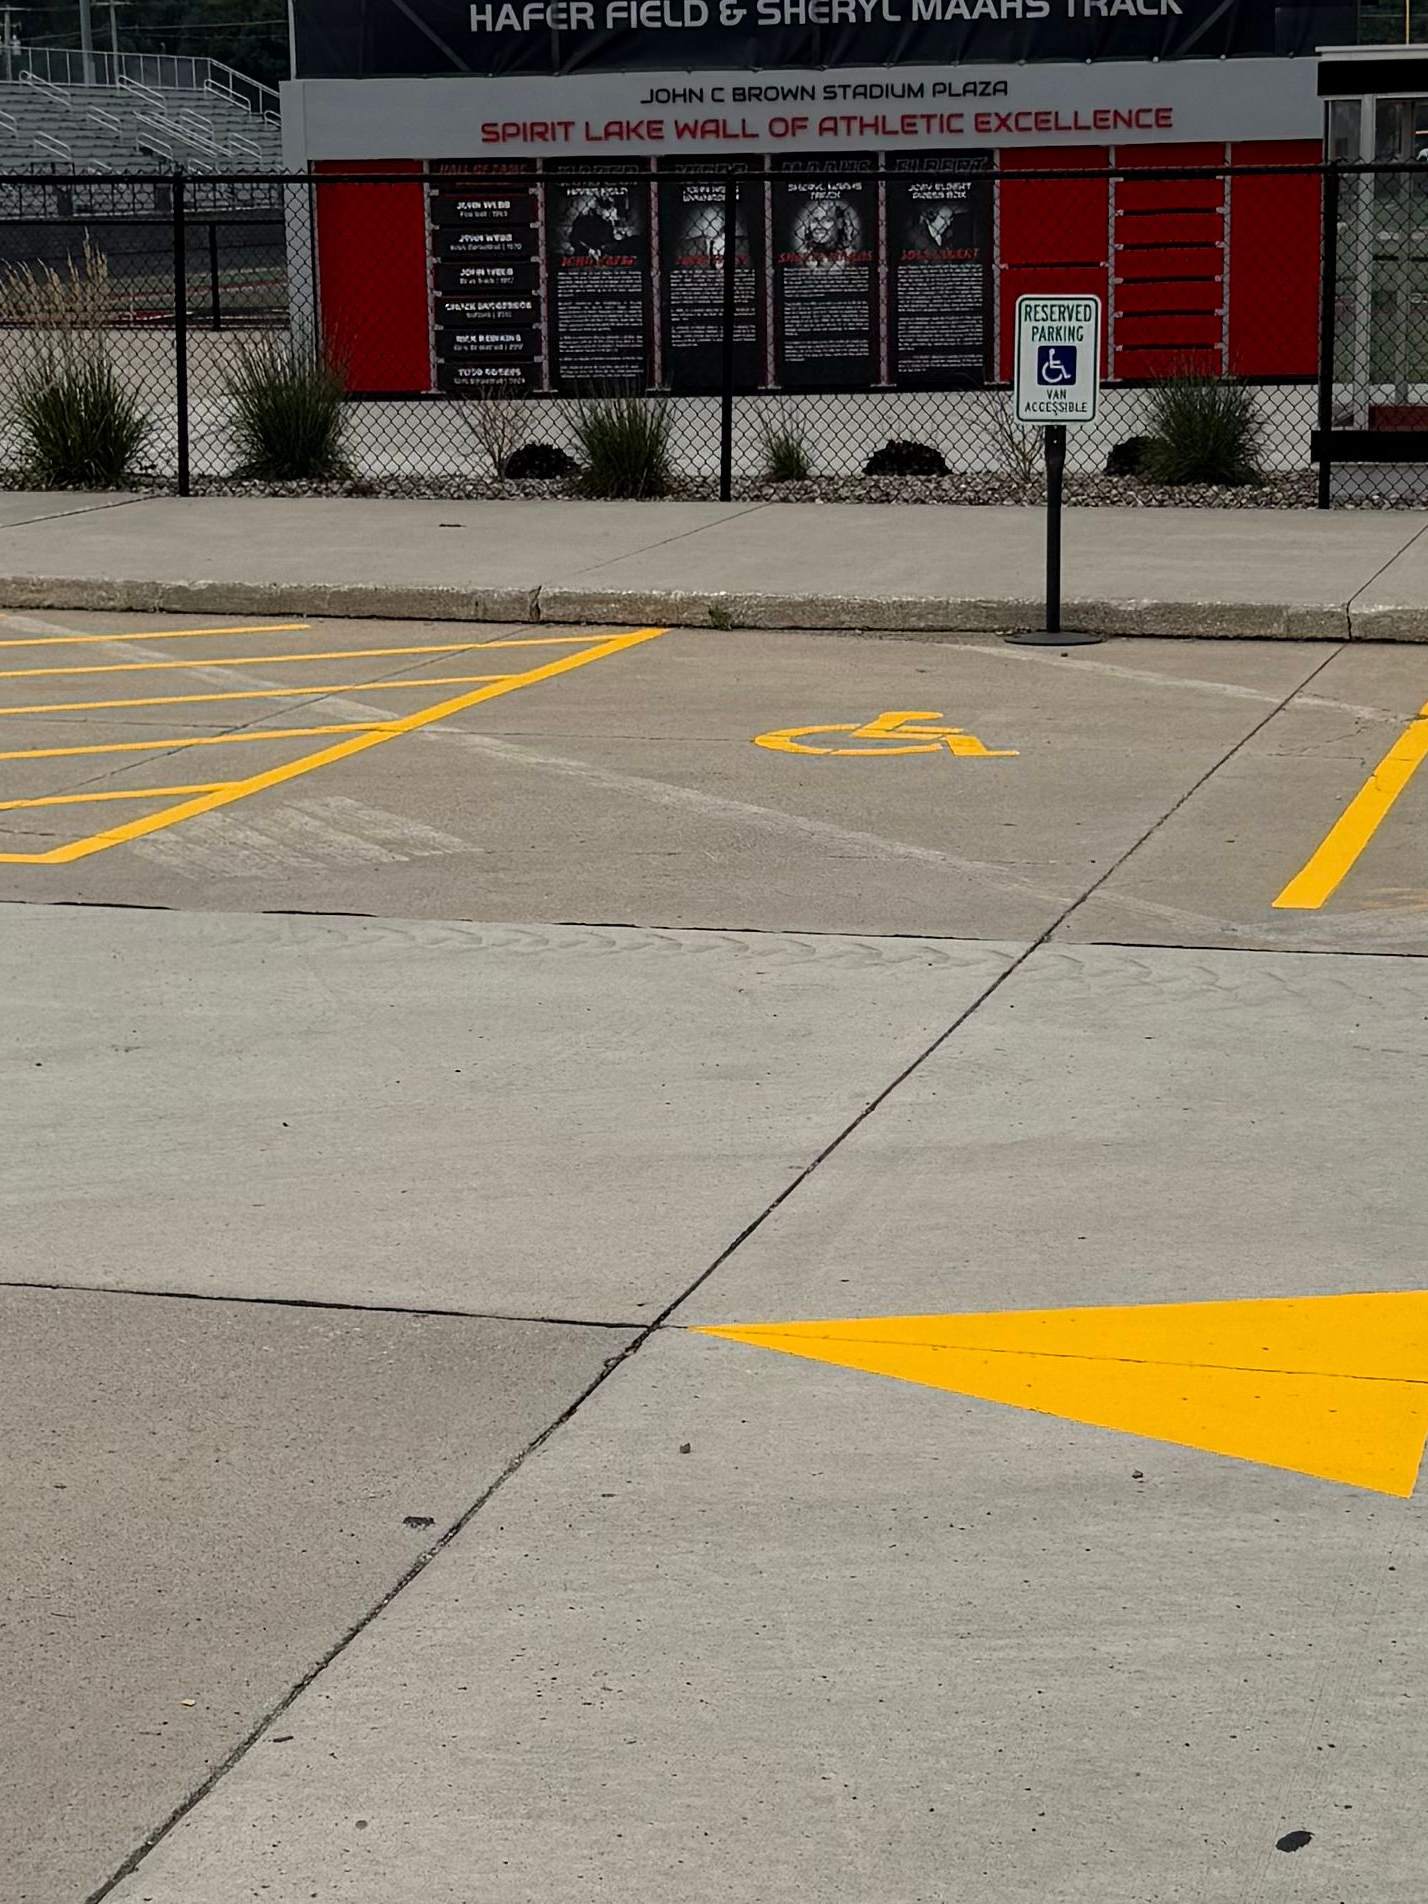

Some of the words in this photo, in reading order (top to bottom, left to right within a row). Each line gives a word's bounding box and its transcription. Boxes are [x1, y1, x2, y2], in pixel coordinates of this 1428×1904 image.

[469, 0, 596, 33] HAFER
[640, 87, 704, 104] JOHN
[711, 87, 725, 103] C
[732, 84, 815, 102] BROWN
[823, 81, 925, 100] STADIUM
[932, 80, 1008, 98] PLAZA
[480, 120, 576, 143] SPIRIT
[585, 119, 665, 141] LAKE
[674, 117, 760, 140] WALL
[768, 116, 810, 138] OF
[818, 112, 965, 137] ATHLETIC
[974, 107, 1174, 133] EXCELLENCE
[1023, 303, 1092, 323] RESERVED
[1031, 325, 1085, 343] PARKING
[1046, 388, 1068, 401] VAN
[1024, 400, 1089, 414] ACCESSIBLE
